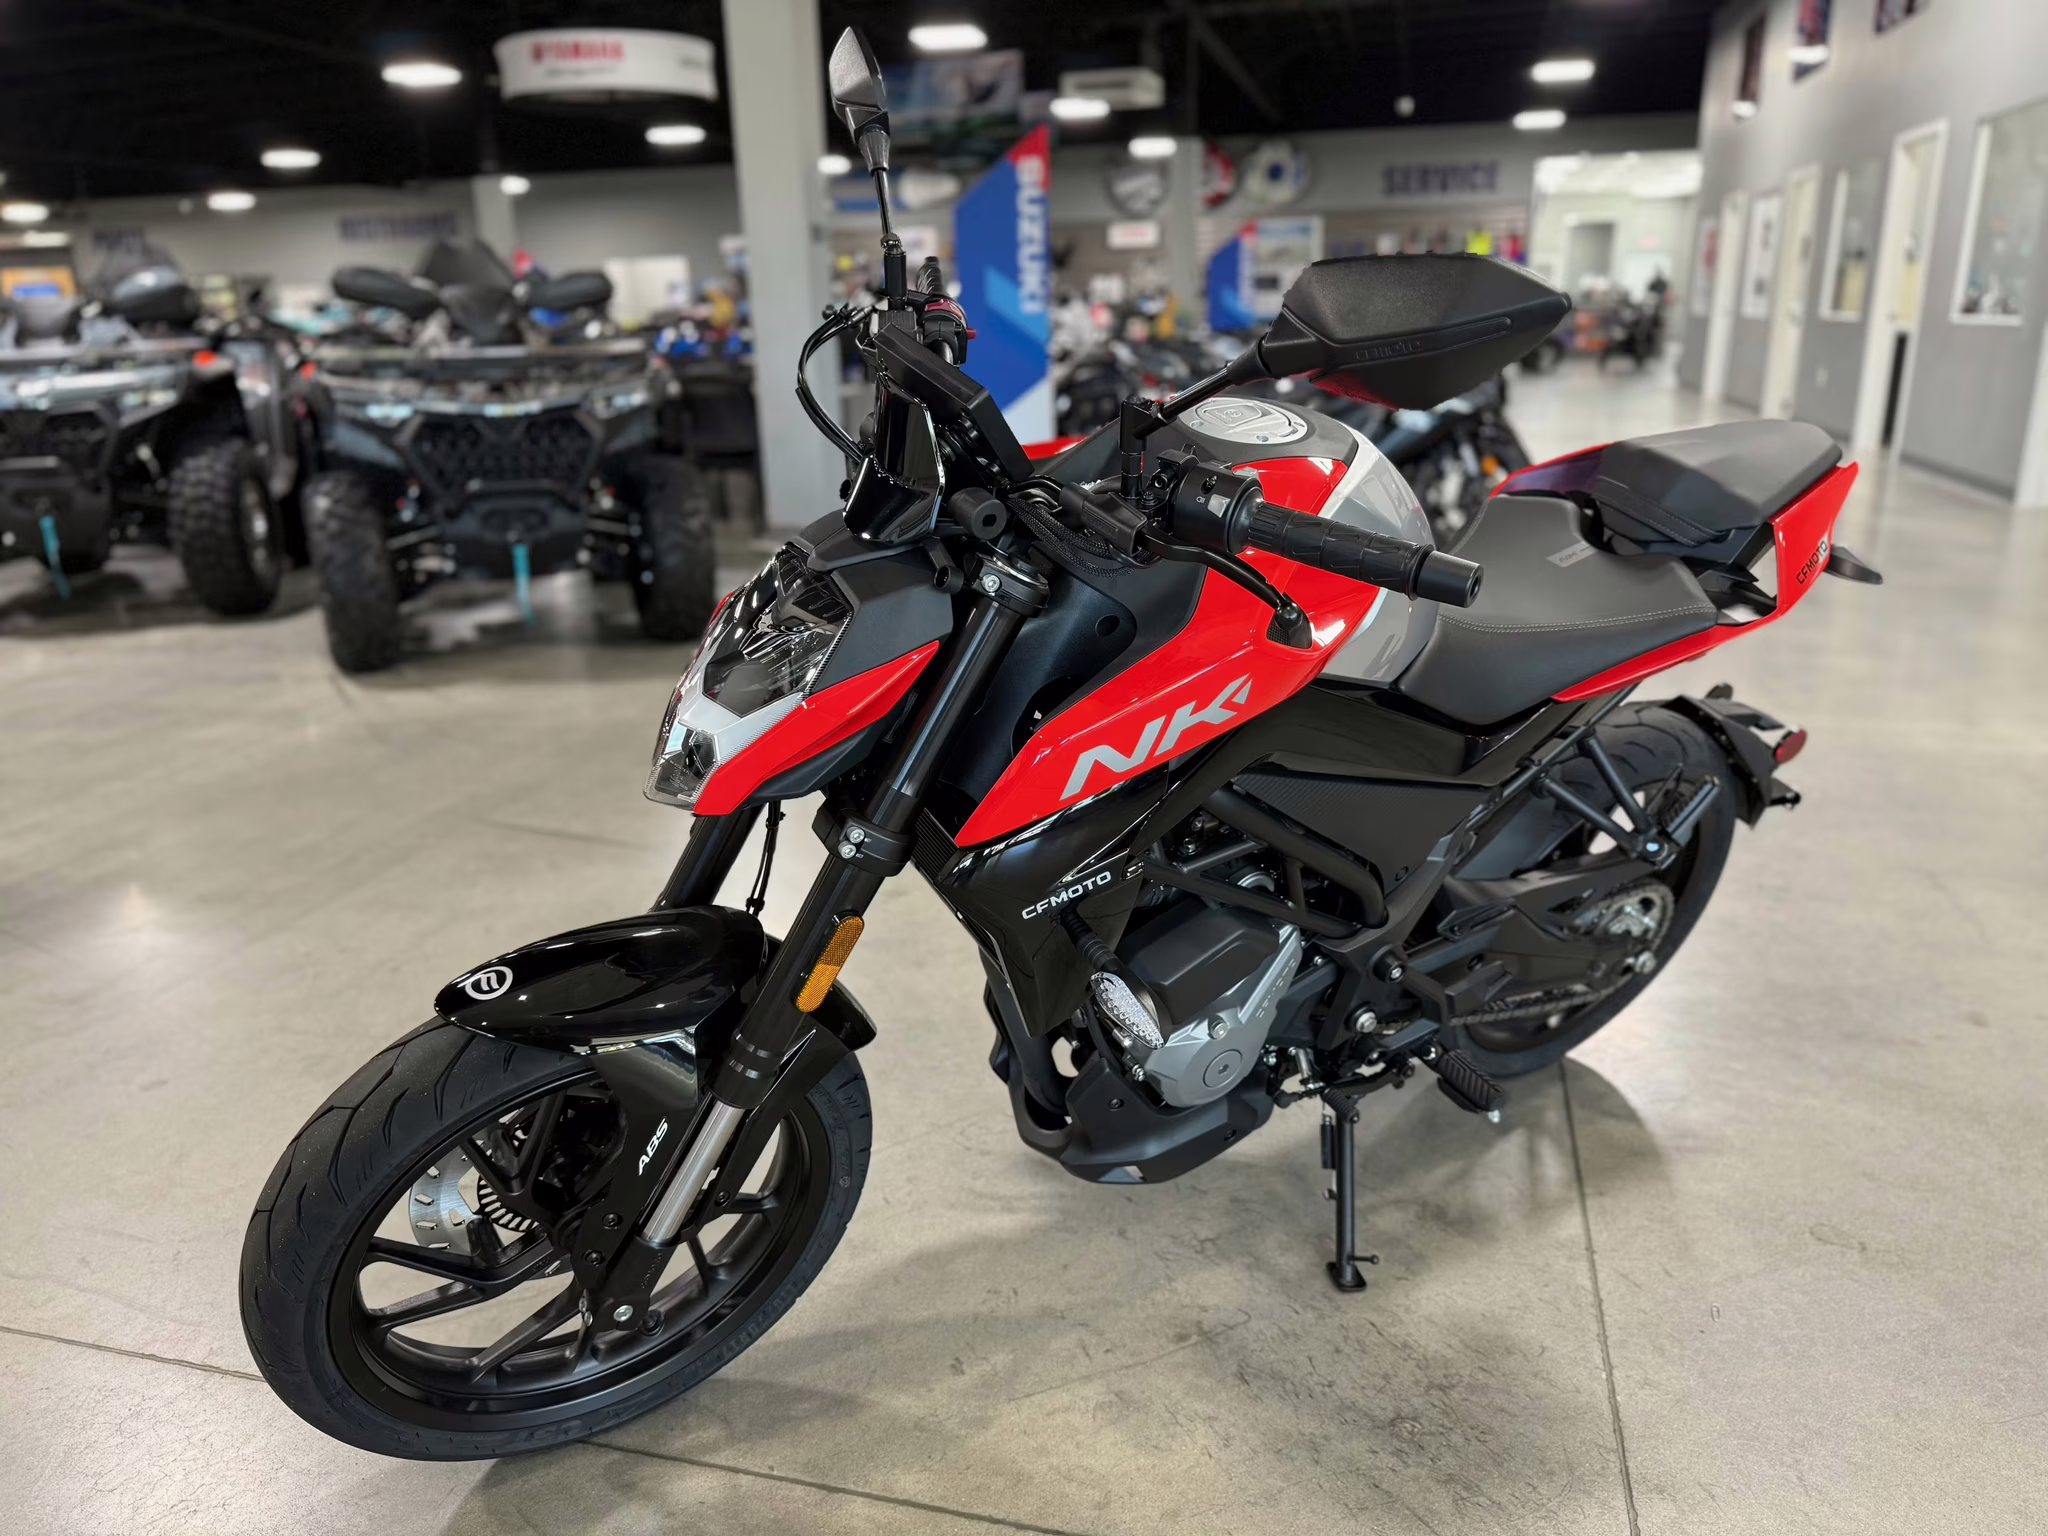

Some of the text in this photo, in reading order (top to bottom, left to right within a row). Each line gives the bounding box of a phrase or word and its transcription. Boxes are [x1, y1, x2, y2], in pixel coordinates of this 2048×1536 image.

[1796, 540, 1829, 585] CFMOTO
[1021, 870, 1112, 920] CFMOTO
[638, 1117, 668, 1177] ABS
